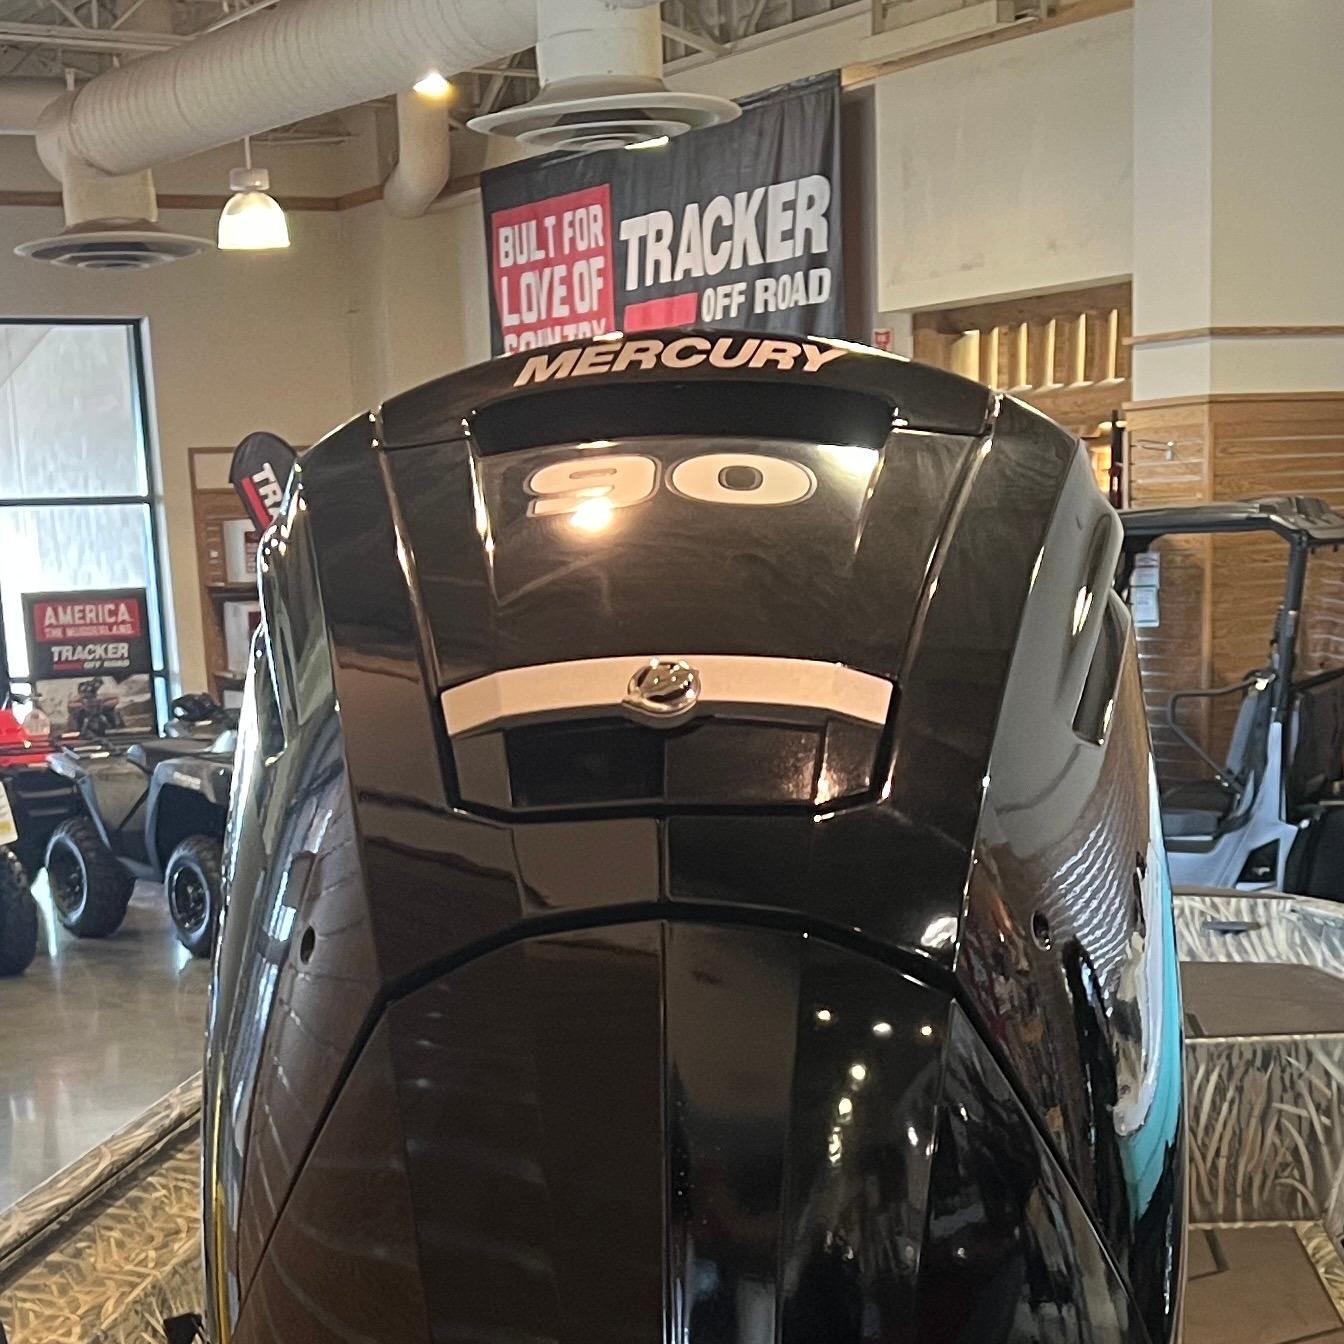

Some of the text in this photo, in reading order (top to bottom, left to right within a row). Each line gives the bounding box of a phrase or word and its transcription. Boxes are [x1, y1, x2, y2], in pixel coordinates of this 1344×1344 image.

[498, 204, 605, 268] BUILT FOR
[619, 174, 832, 291] TRACKER
[501, 256, 605, 327] LOVE OF
[701, 267, 832, 323] OFF ROAD
[513, 336, 849, 388] MERCURY
[523, 452, 818, 518] 90
[43, 603, 134, 627] AMERICA
[51, 642, 129, 662] TRACKER
